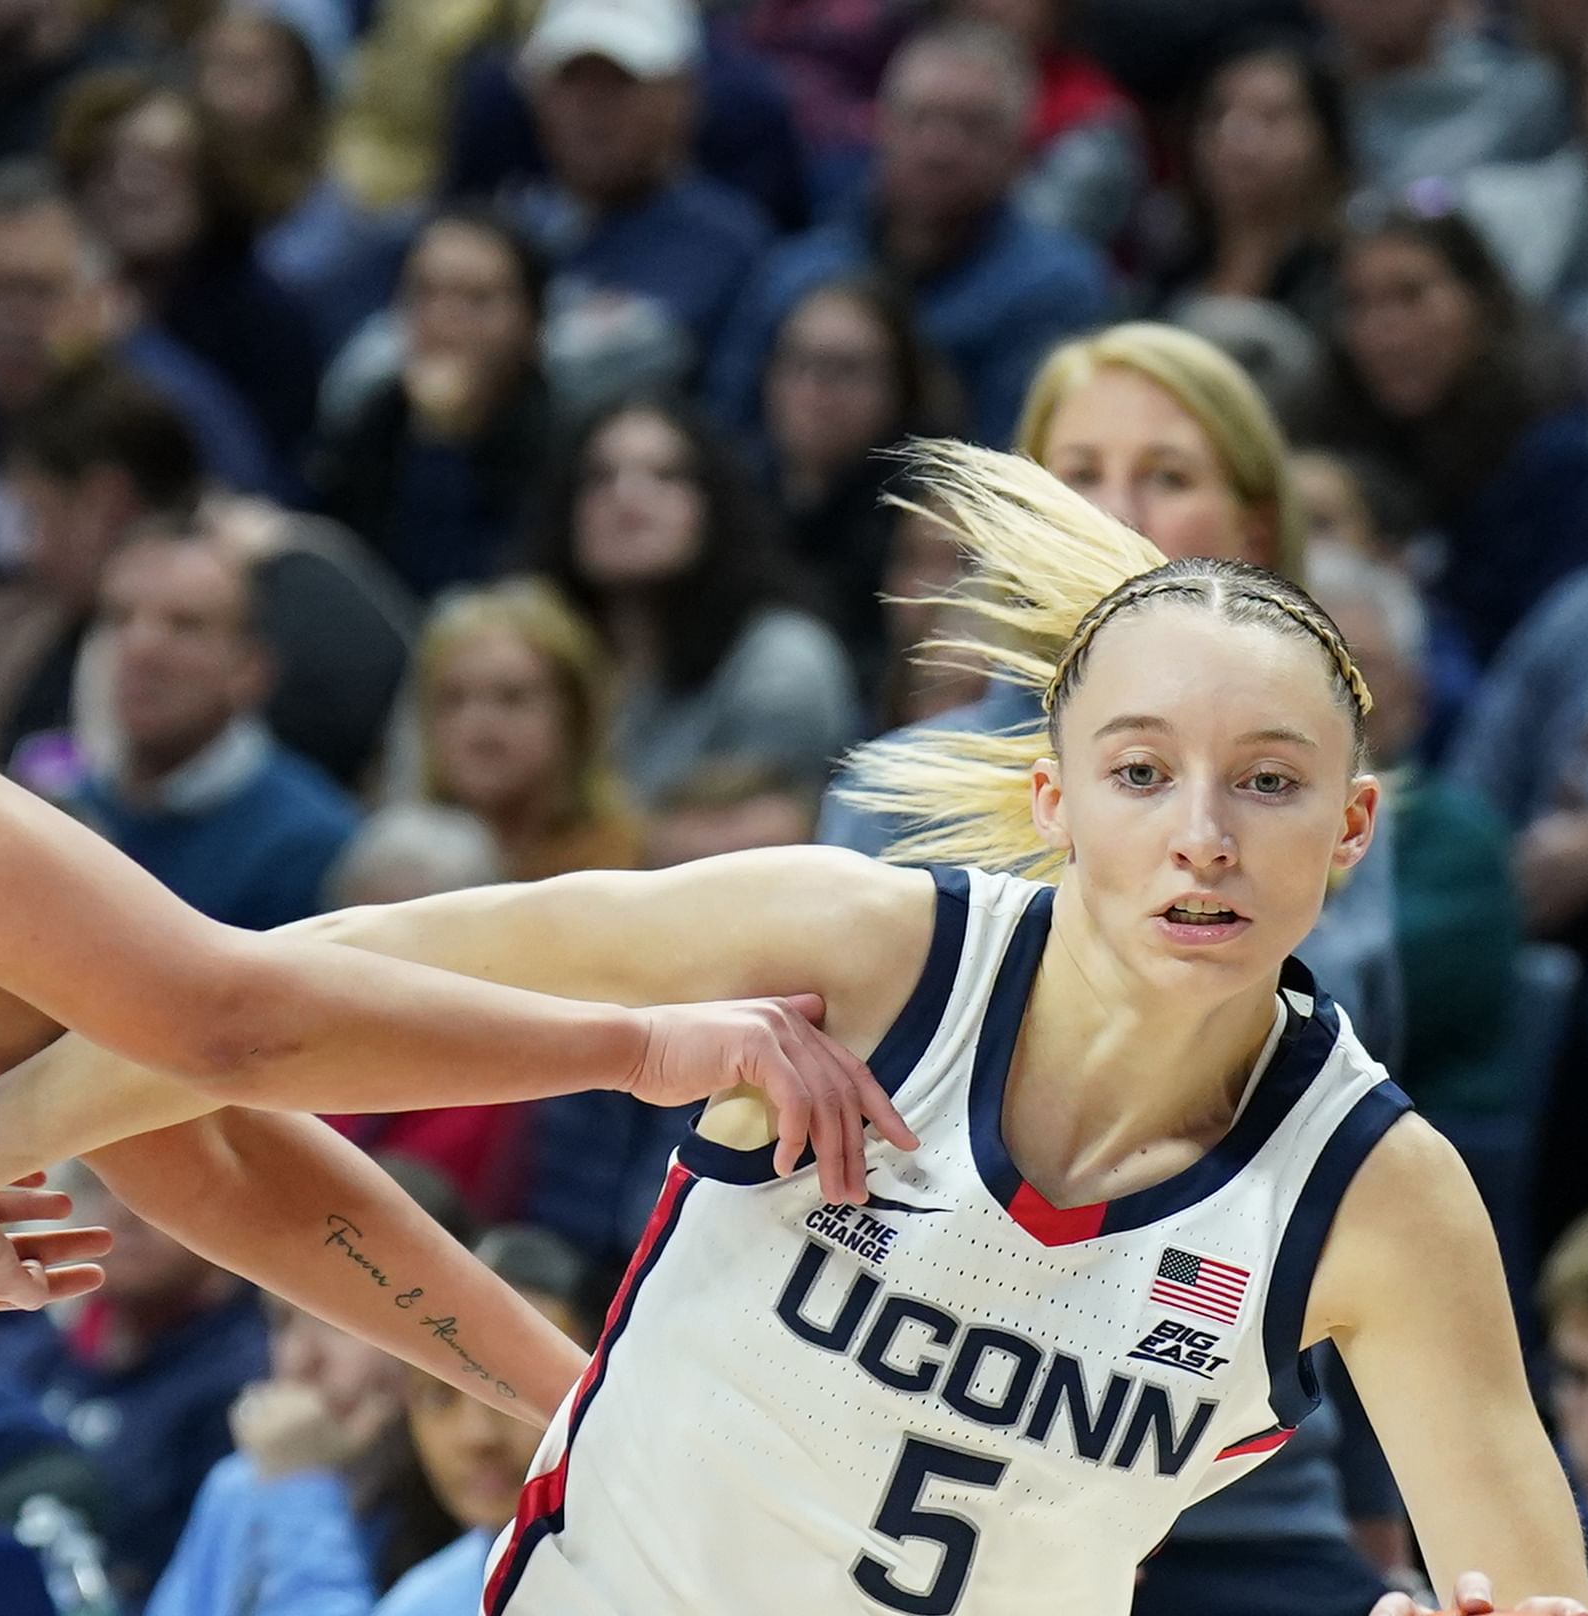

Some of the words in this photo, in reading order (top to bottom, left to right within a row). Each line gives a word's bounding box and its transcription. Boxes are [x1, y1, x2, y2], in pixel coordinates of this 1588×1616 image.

[805, 1210, 890, 1265] CHANGE
[822, 1203, 857, 1223] BE
[854, 1213, 898, 1247] THE
[324, 1214, 391, 1287] Forever
[420, 1316, 491, 1381] Always
[773, 1238, 1220, 1478] UCONN
[1135, 1334, 1230, 1372] EAST
[1151, 1319, 1220, 1351] BIG
